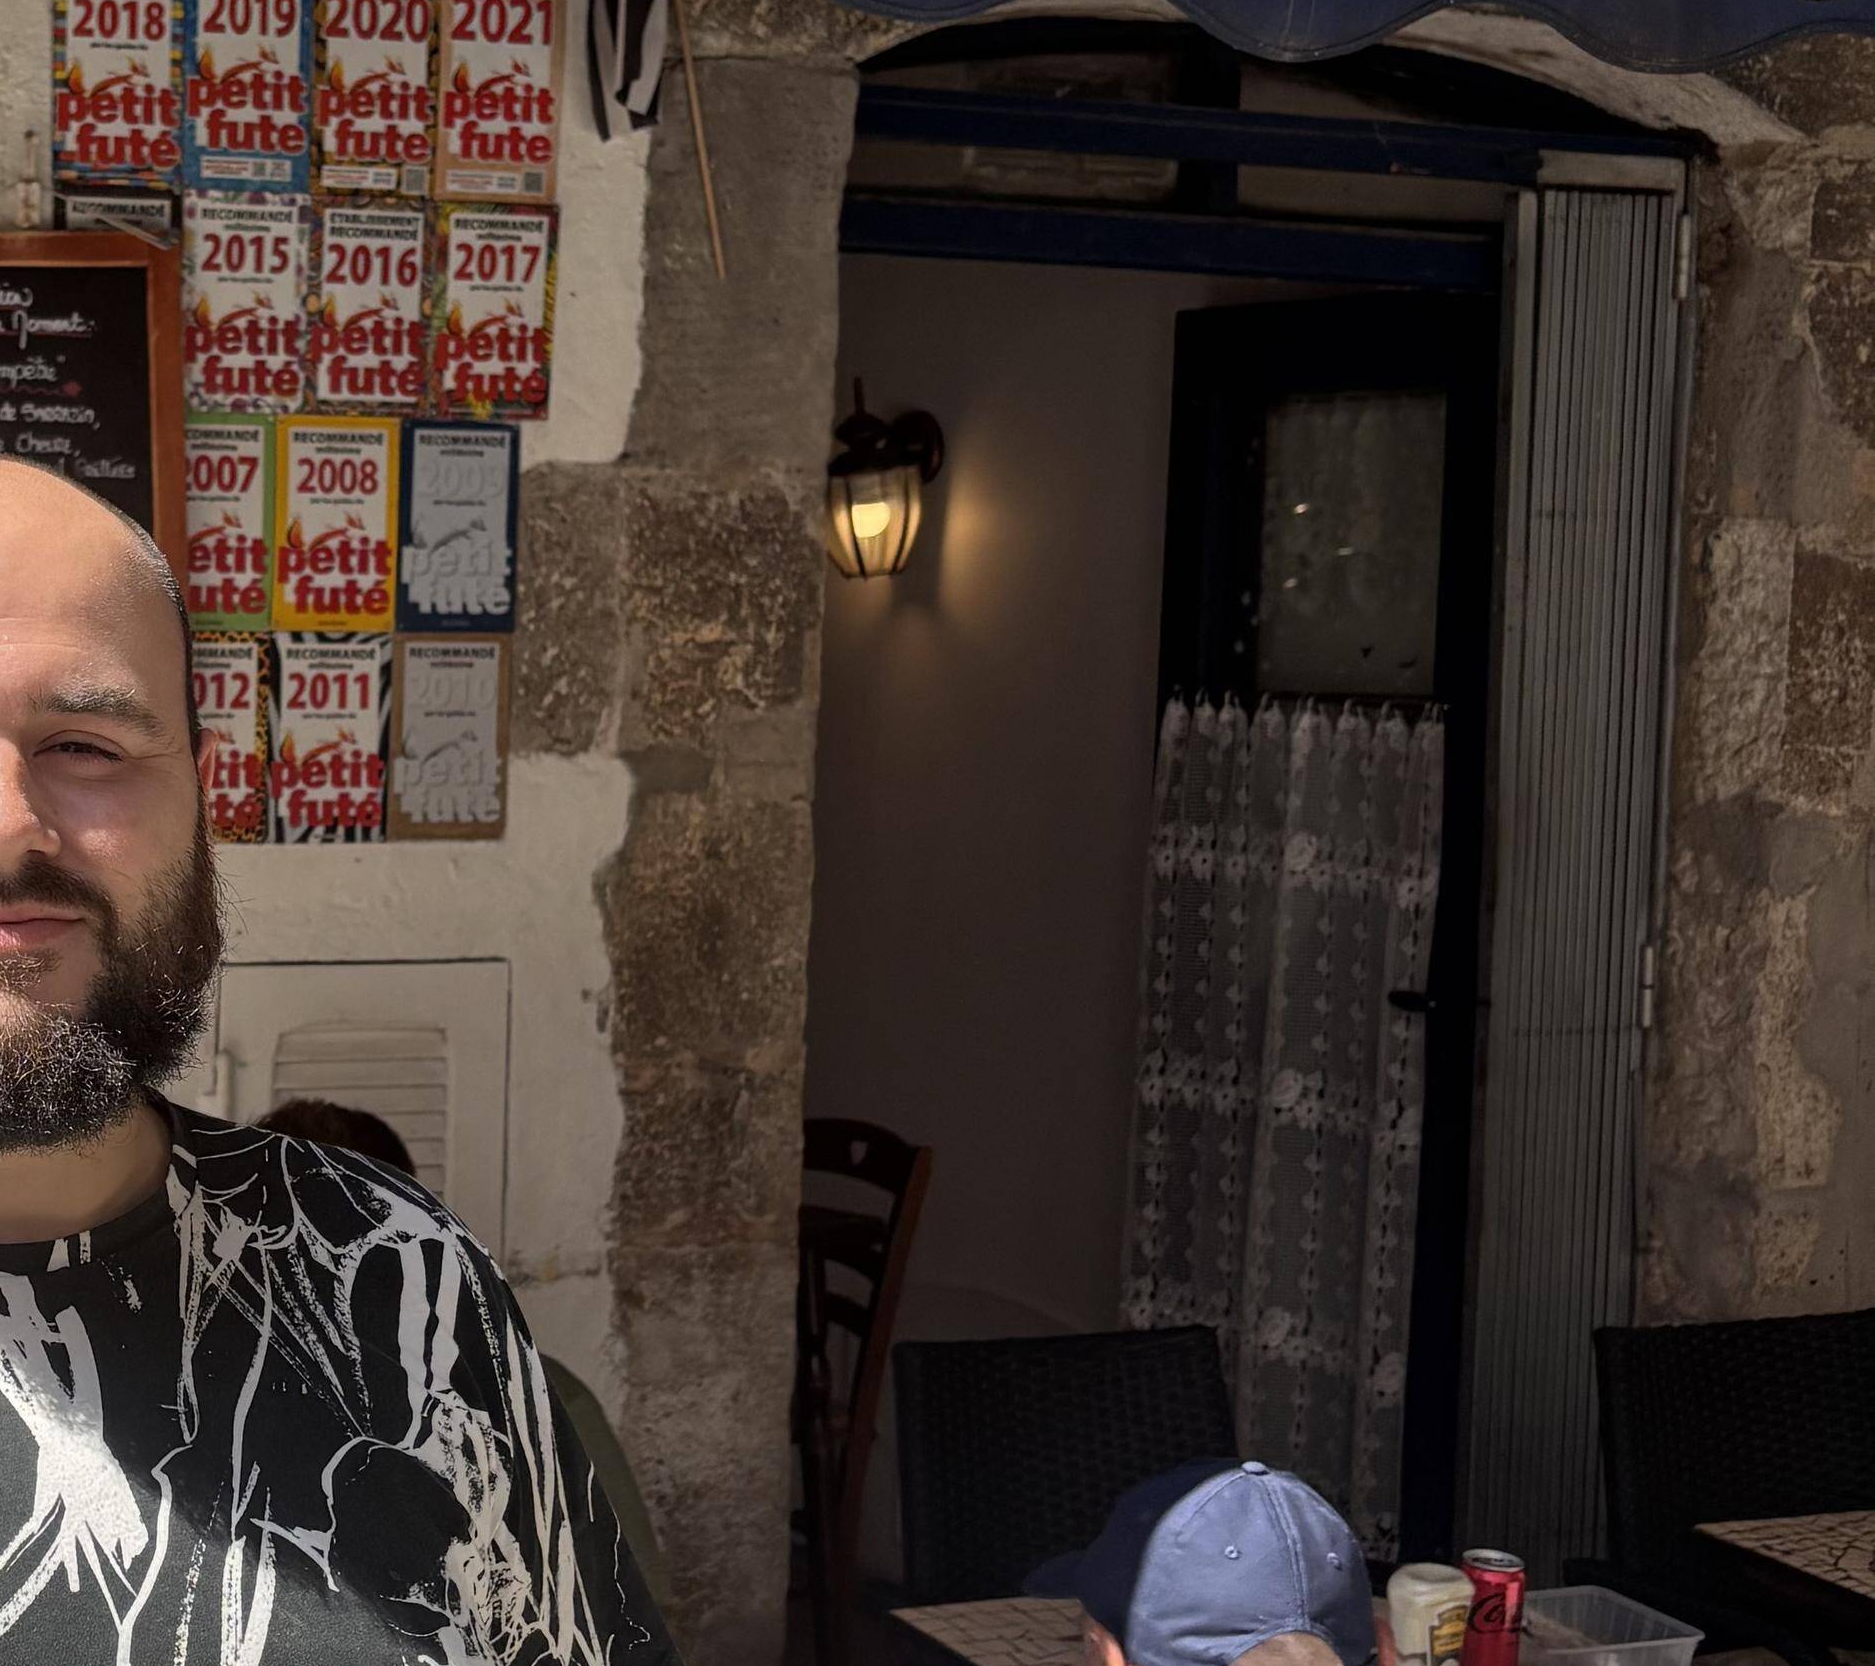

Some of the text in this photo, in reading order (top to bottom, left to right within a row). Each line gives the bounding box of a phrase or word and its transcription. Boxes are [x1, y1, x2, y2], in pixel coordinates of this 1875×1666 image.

[56, 84, 180, 132] petit
[187, 70, 307, 117] petit
[317, 81, 433, 127] petit
[443, 83, 555, 129] petit
[77, 123, 181, 170] futé
[201, 233, 290, 274] 2015
[326, 243, 419, 287] 2016
[453, 243, 543, 283] 2017
[184, 315, 300, 363] petit
[308, 316, 425, 364] petit
[433, 321, 550, 371] petit
[202, 355, 300, 397] futé
[327, 355, 425, 397] futé
[452, 362, 547, 404] futé
[186, 454, 260, 493] 007
[297, 457, 379, 495] 2008
[276, 536, 393, 584] petit
[294, 574, 389, 615] futé
[286, 672, 370, 711] 2011
[269, 749, 385, 799] petit
[287, 789, 383, 829] futé
